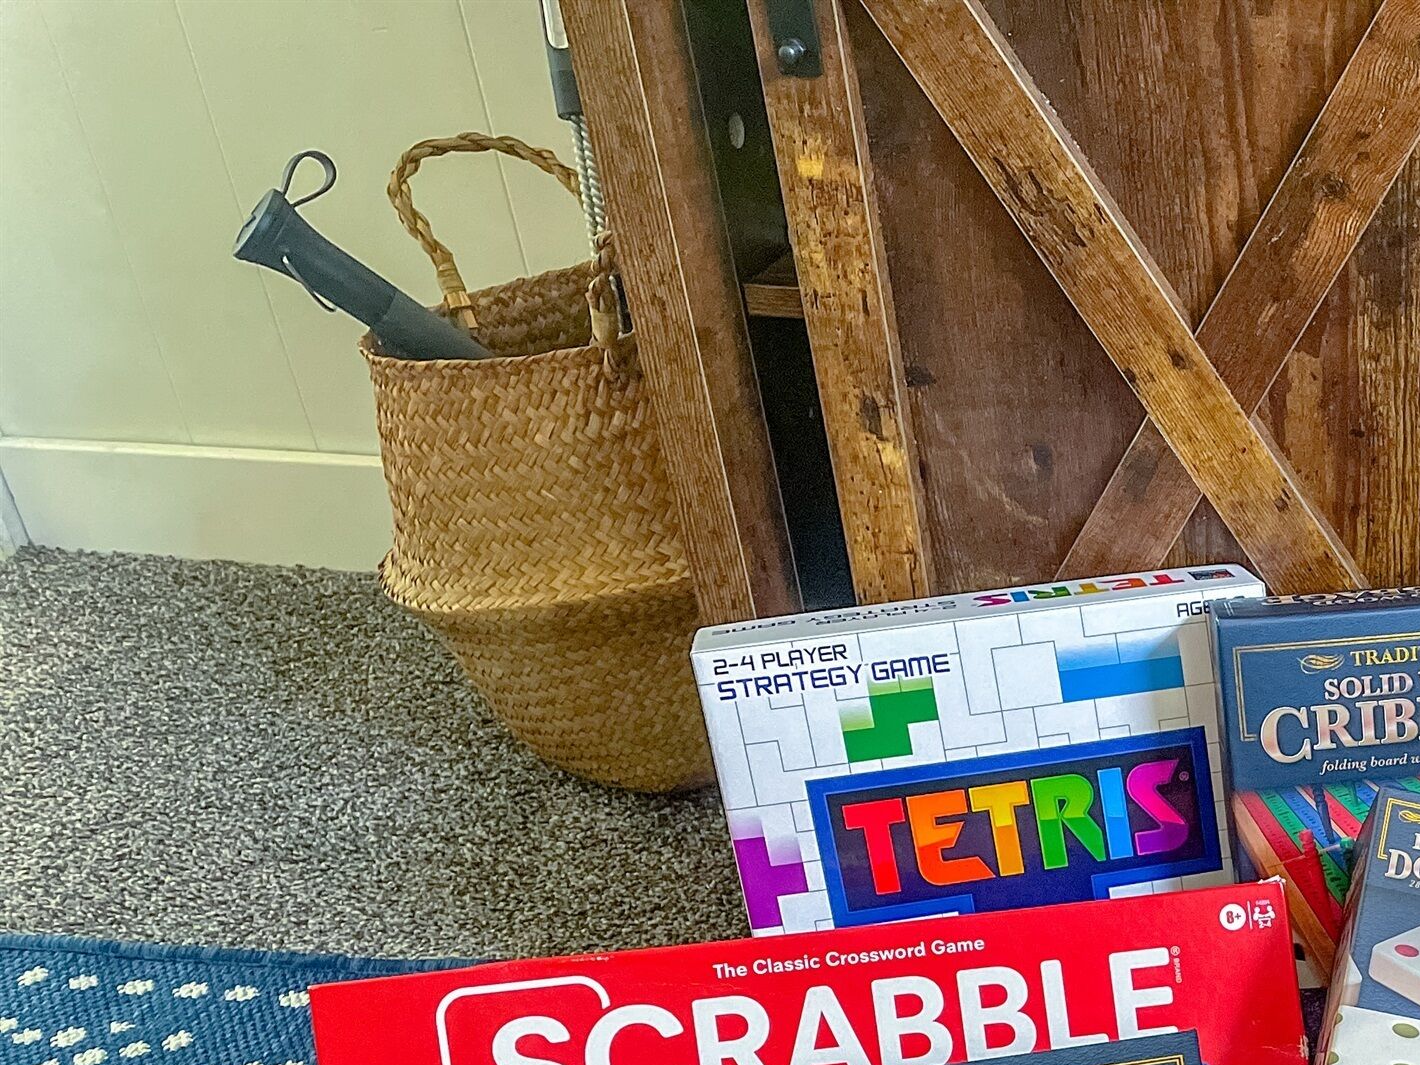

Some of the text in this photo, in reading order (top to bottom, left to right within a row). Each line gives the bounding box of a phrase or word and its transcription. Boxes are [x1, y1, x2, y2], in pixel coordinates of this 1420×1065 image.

[1176, 600, 1211, 617] AGE
[713, 643, 848, 676] 2-4 PLAYER
[716, 653, 952, 701] STRATEGY GAME
[1323, 672, 1414, 700] SOLID
[1320, 758, 1367, 776] folding
[1370, 753, 1407, 769] board
[841, 759, 1192, 895] TETRIS
[1409, 879, 1420, 889] 28
[712, 936, 985, 979] The Classic Crossword Game
